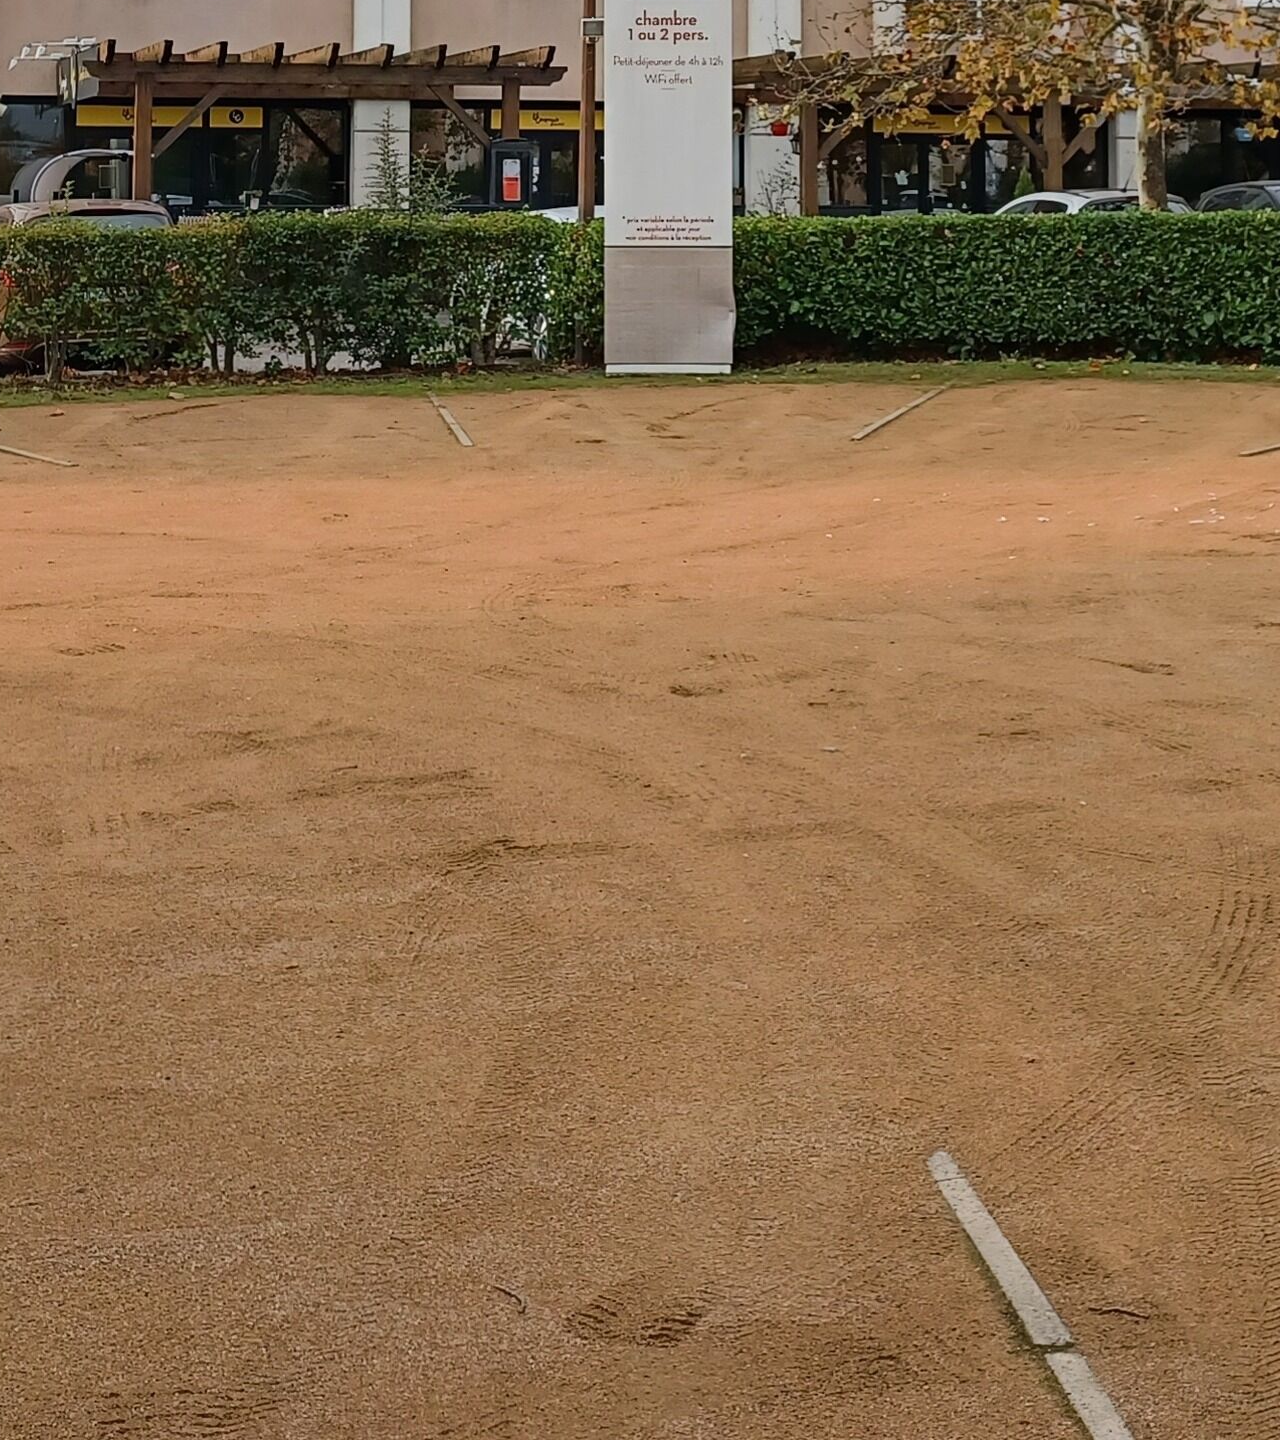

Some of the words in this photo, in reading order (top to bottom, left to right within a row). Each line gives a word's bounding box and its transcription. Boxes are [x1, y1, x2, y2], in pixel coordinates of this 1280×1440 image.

[635, 9, 698, 26] chambre
[628, 28, 633, 40] 1
[638, 30, 656, 41] ou
[659, 28, 669, 41] 2
[673, 31, 709, 45] pers.
[674, 55, 686, 66] de
[668, 73, 693, 84] offert
